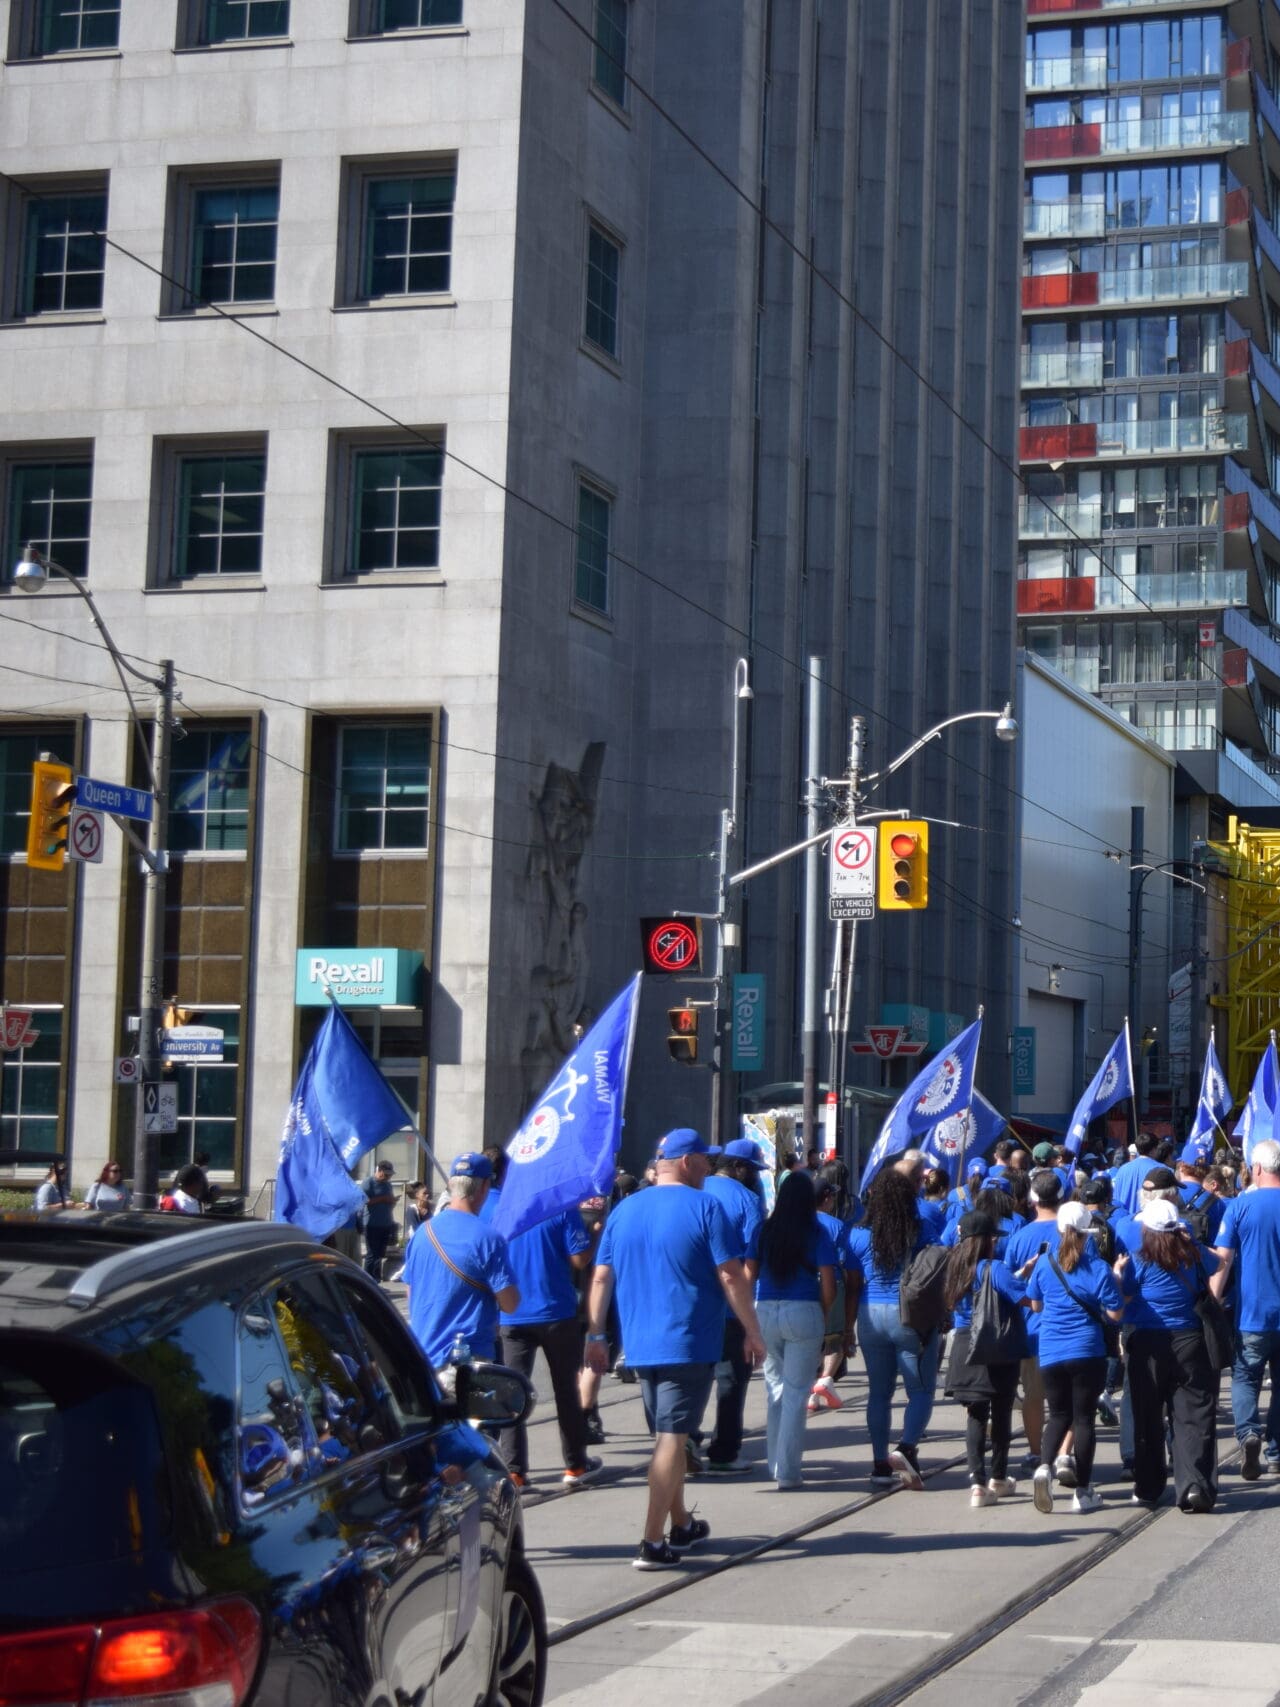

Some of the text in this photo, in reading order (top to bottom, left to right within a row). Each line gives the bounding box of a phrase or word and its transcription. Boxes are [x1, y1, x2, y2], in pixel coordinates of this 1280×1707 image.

[84, 781, 121, 808] Queen
[136, 794, 147, 813] W
[833, 909, 871, 917] EXCEPTED
[310, 957, 384, 986] Rexall
[336, 984, 385, 996] Drugstore
[735, 988, 759, 1057] Rexall
[594, 1050, 613, 1104] IAMAW
[1015, 1036, 1033, 1086] Rexall
